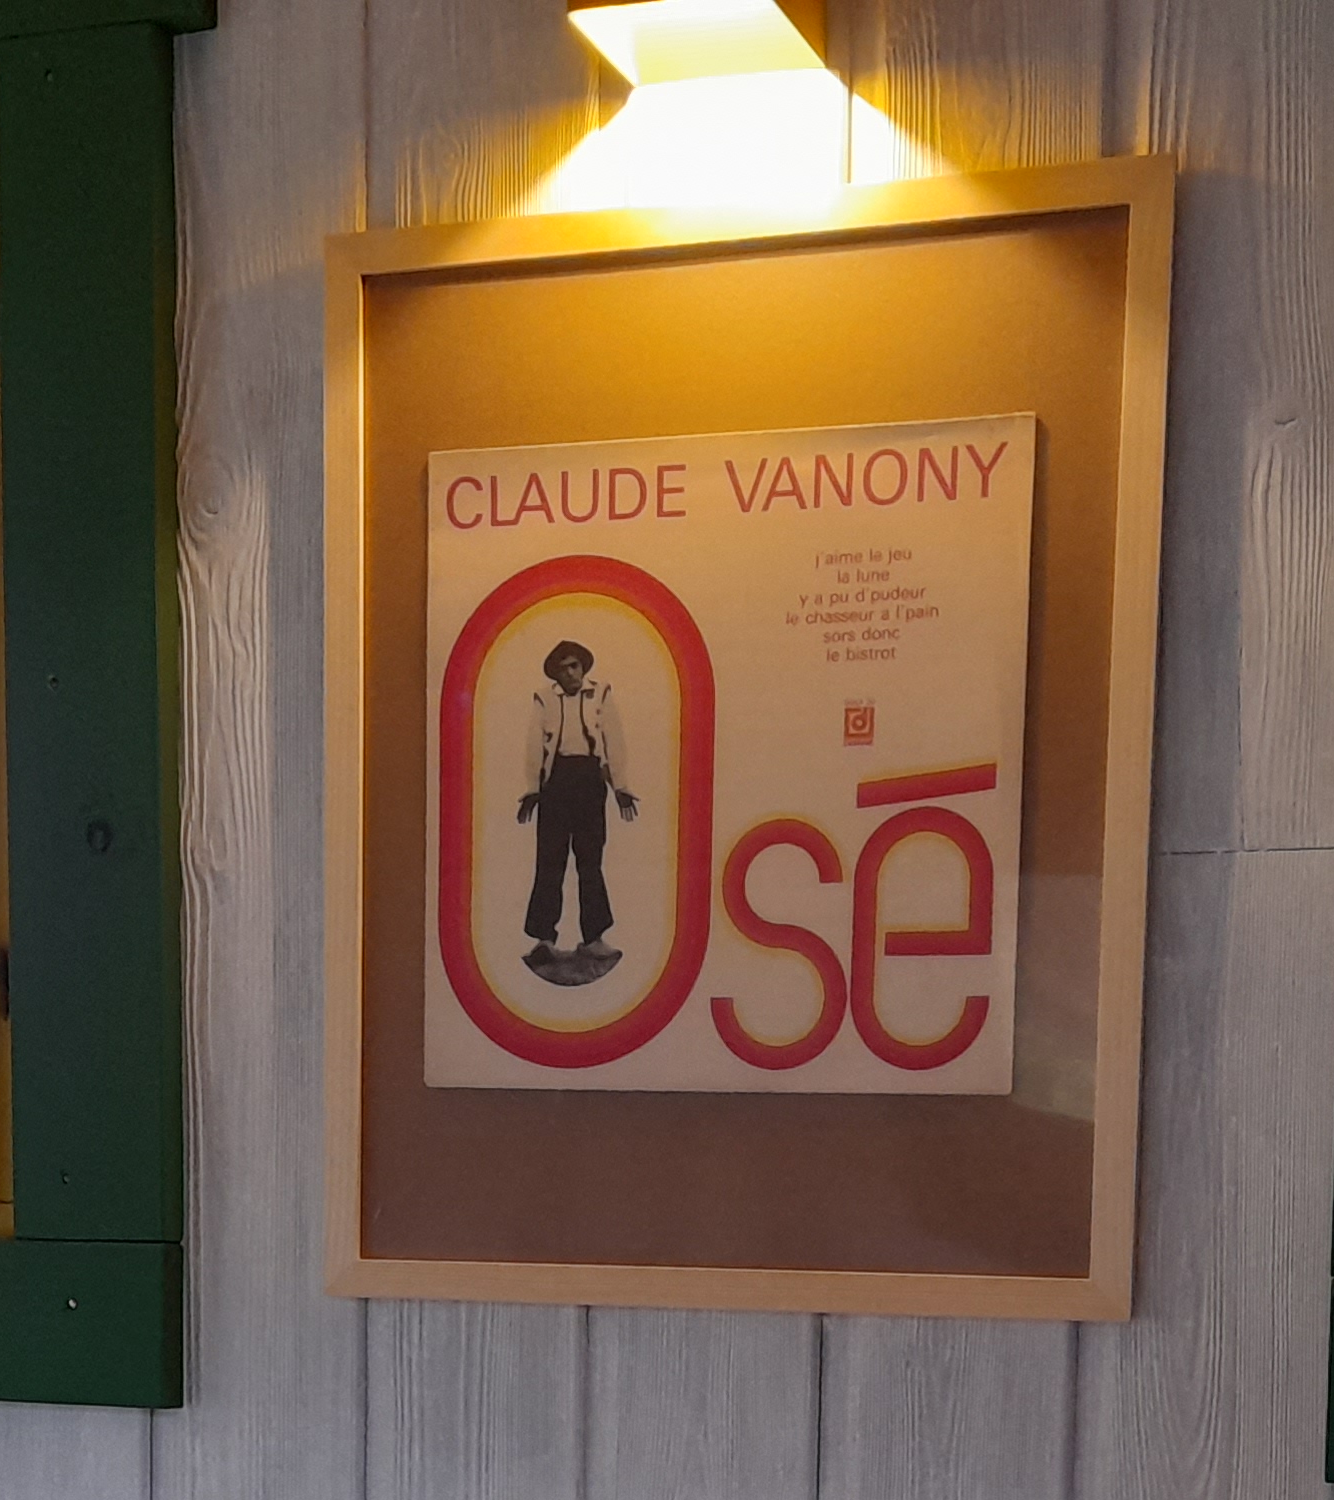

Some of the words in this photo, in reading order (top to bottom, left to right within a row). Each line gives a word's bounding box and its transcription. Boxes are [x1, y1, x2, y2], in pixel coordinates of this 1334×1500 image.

[446, 464, 686, 530] CLAUDE
[724, 441, 1008, 513] VANONY
[815, 550, 863, 568] j'aime
[869, 548, 883, 562] le
[888, 548, 911, 564] jeu
[837, 570, 850, 584] la
[856, 568, 890, 583] lune
[799, 594, 809, 608] y
[814, 593, 823, 604] a
[829, 592, 849, 607] pu
[855, 586, 927, 605] d'pudeur
[785, 611, 799, 626] le
[805, 608, 875, 625] chasseur
[823, 629, 856, 644] sors
[861, 627, 901, 641] donc
[826, 649, 840, 663] le
[846, 647, 897, 661] bistrot
[437, 554, 997, 1071] Osé
